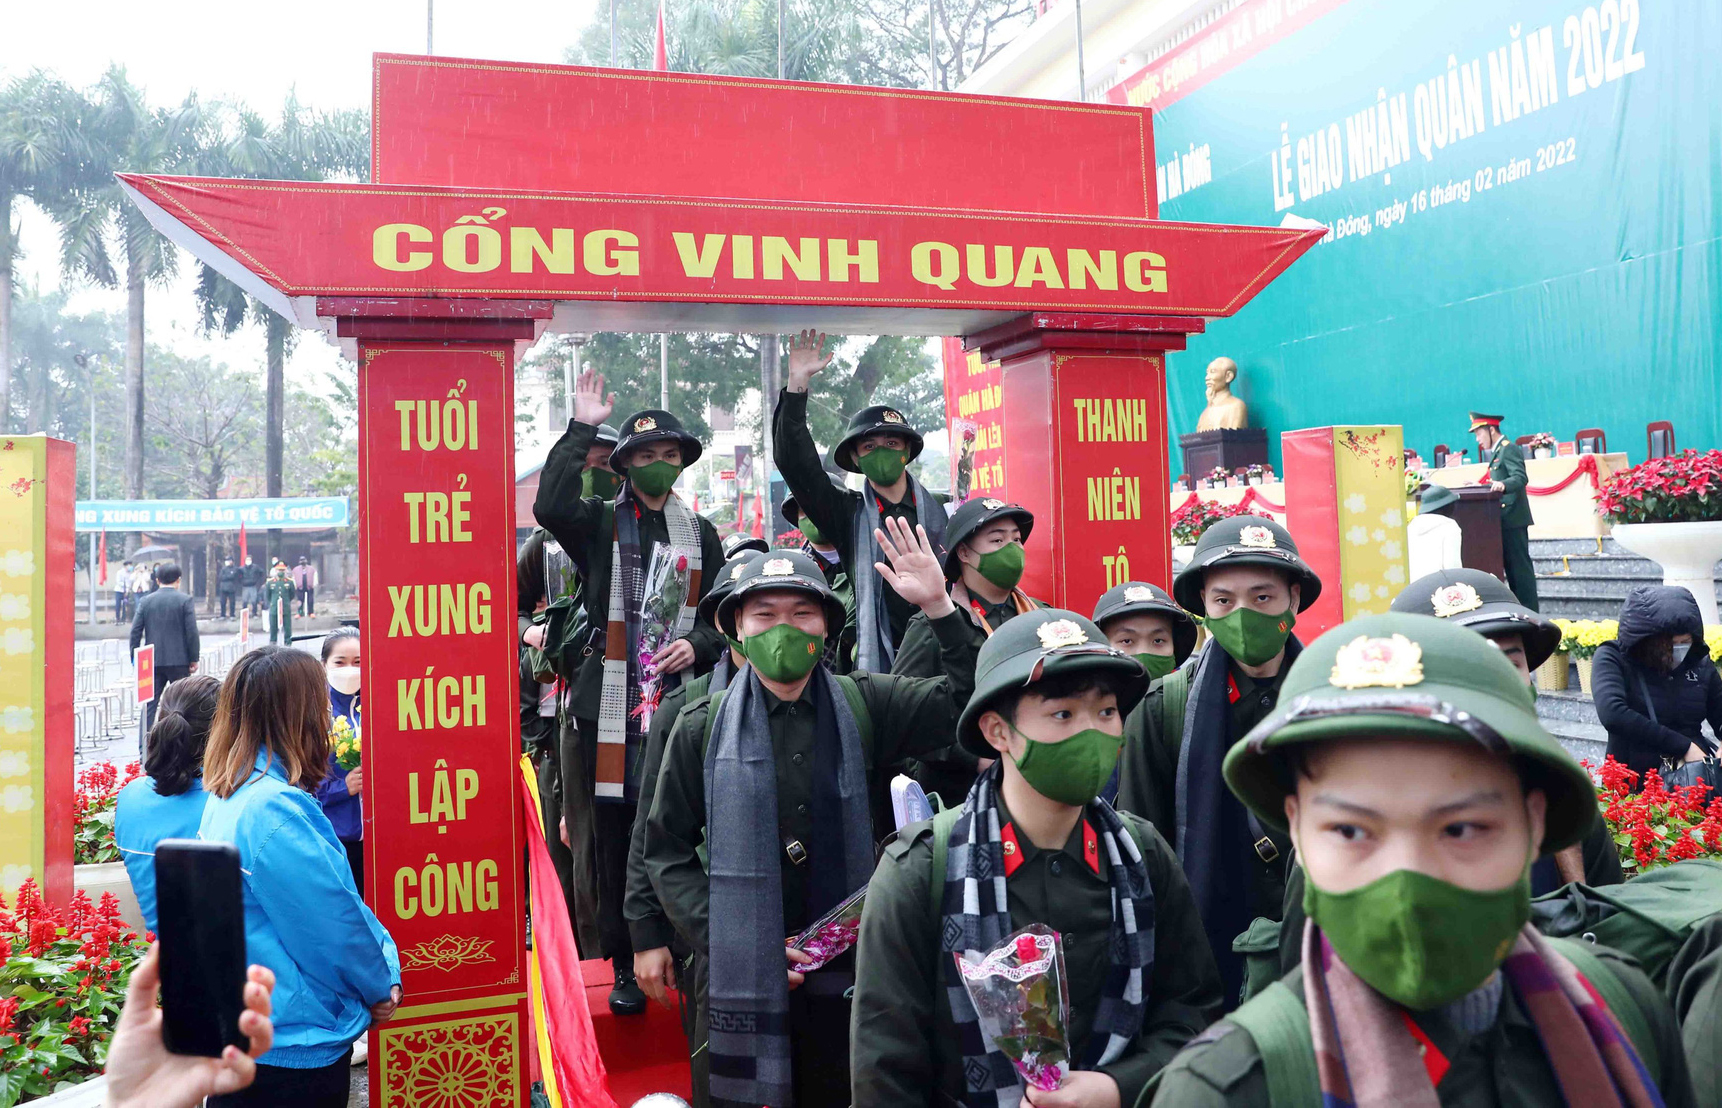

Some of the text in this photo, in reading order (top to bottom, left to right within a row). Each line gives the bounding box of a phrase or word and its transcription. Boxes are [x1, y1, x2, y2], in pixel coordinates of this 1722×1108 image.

[1271, 121, 1295, 212] LỄ
[1297, 123, 1344, 202] GIAO
[1346, 86, 1411, 186] NHẬN
[1414, 53, 1485, 163] QUÂN
[1488, 22, 1559, 127] NĂM
[1563, 0, 1646, 97] 2022
[1336, 214, 1372, 240] Đông,
[1375, 199, 1408, 229] ngày
[1411, 190, 1427, 214] 16
[1430, 179, 1472, 208] tháng
[1475, 167, 1493, 192] 02
[1497, 157, 1531, 186] năm
[1536, 137, 1577, 173] 2022
[373, 207, 1168, 293] CỔNG VINH QUANG
[394, 378, 479, 451] TUỔI
[1073, 398, 1148, 442] THANH
[102, 509, 151, 524] XUNG
[155, 506, 196, 523] KÍCH
[290, 502, 334, 521] QUỐC
[404, 473, 473, 543] TRẺ
[1087, 467, 1141, 521] NIÊN
[387, 582, 492, 638] XUNG
[397, 666, 487, 731] KÍCH
[408, 758, 479, 835] LẬP
[394, 853, 499, 920] CÔNG
